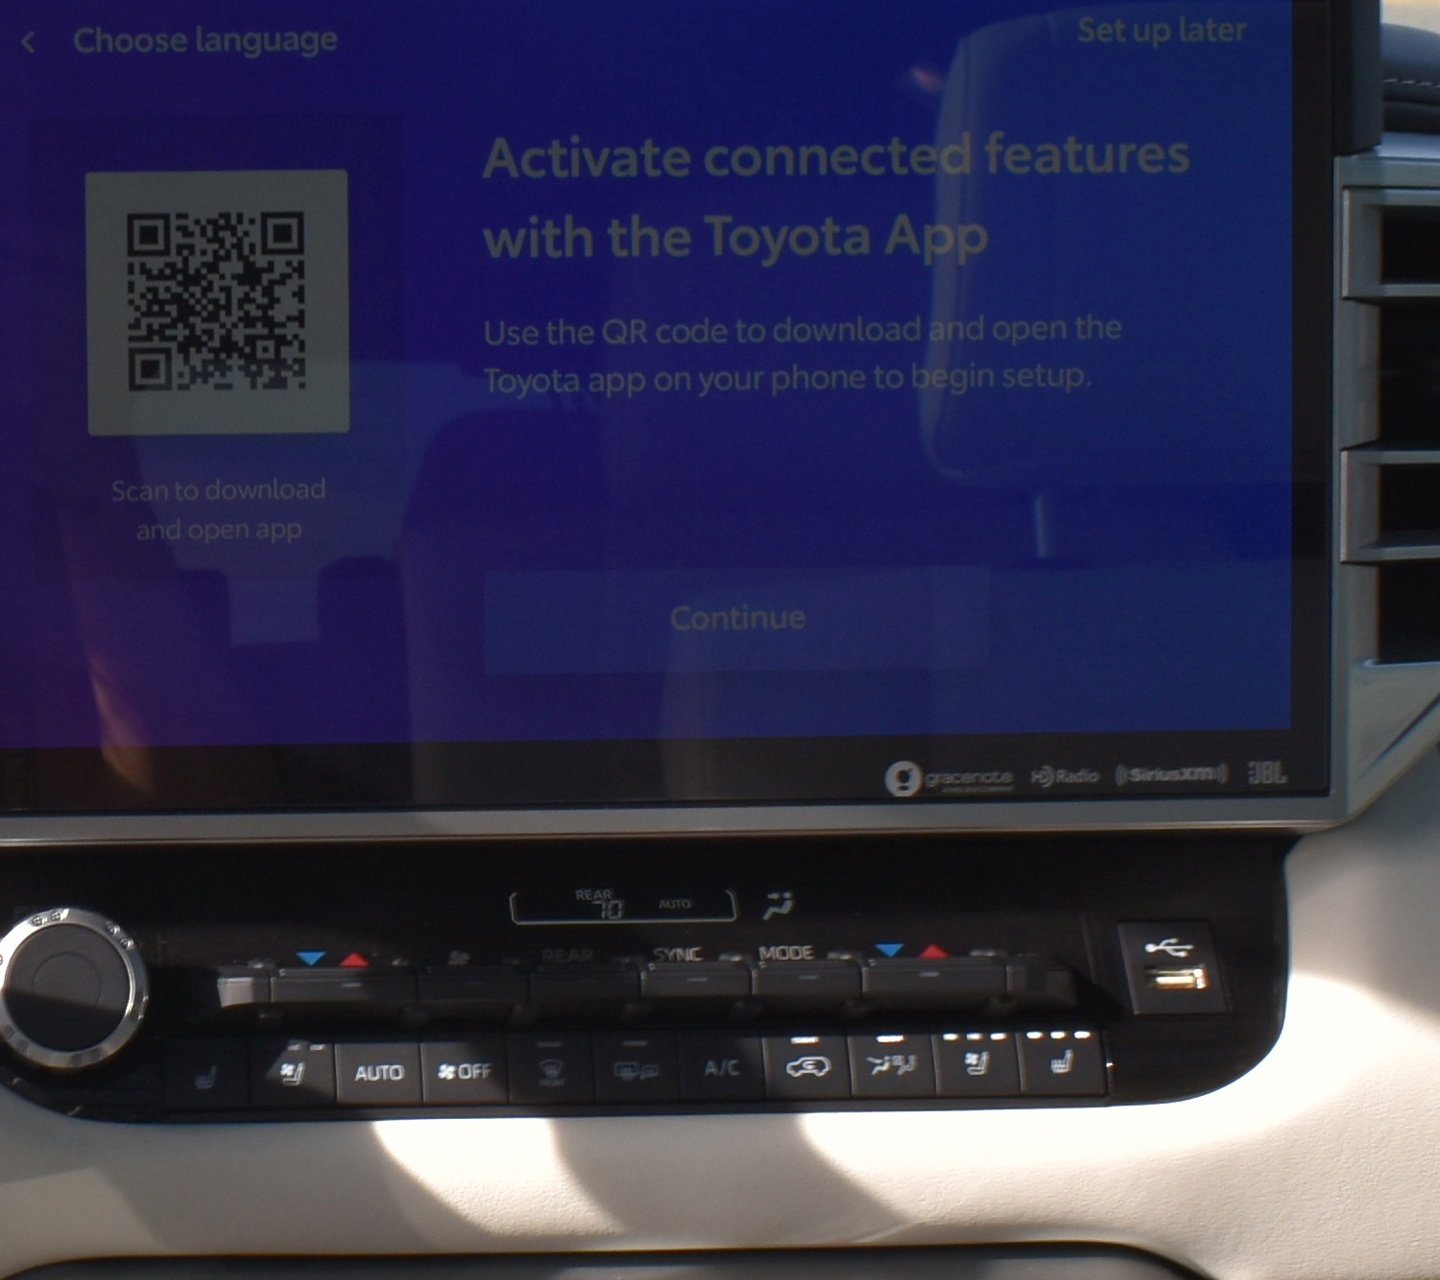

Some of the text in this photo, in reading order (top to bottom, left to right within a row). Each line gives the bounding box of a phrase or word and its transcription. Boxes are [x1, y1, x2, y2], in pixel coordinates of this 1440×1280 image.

[72, 25, 338, 58] Choose language
[1078, 16, 1248, 49] Set up later
[481, 130, 1191, 180] Activate connected features
[481, 213, 989, 268] with the Toyota App
[484, 312, 1123, 346] Use the QR code to download and open the
[483, 361, 1094, 401] Toyota app on your phone to begin setup.
[111, 475, 327, 502] Scan to download
[136, 516, 304, 545] and open app
[670, 604, 806, 631] Continue
[1247, 761, 1289, 786] JBL
[575, 888, 616, 901] REAR
[658, 898, 694, 910] AUTO
[591, 899, 625, 921] 70
[541, 948, 595, 963] REAR
[652, 945, 705, 963] SYNC
[757, 944, 817, 961] MODE
[353, 1063, 406, 1082] AUTO
[456, 1062, 494, 1081] OFF
[703, 1058, 741, 1078] A/C
